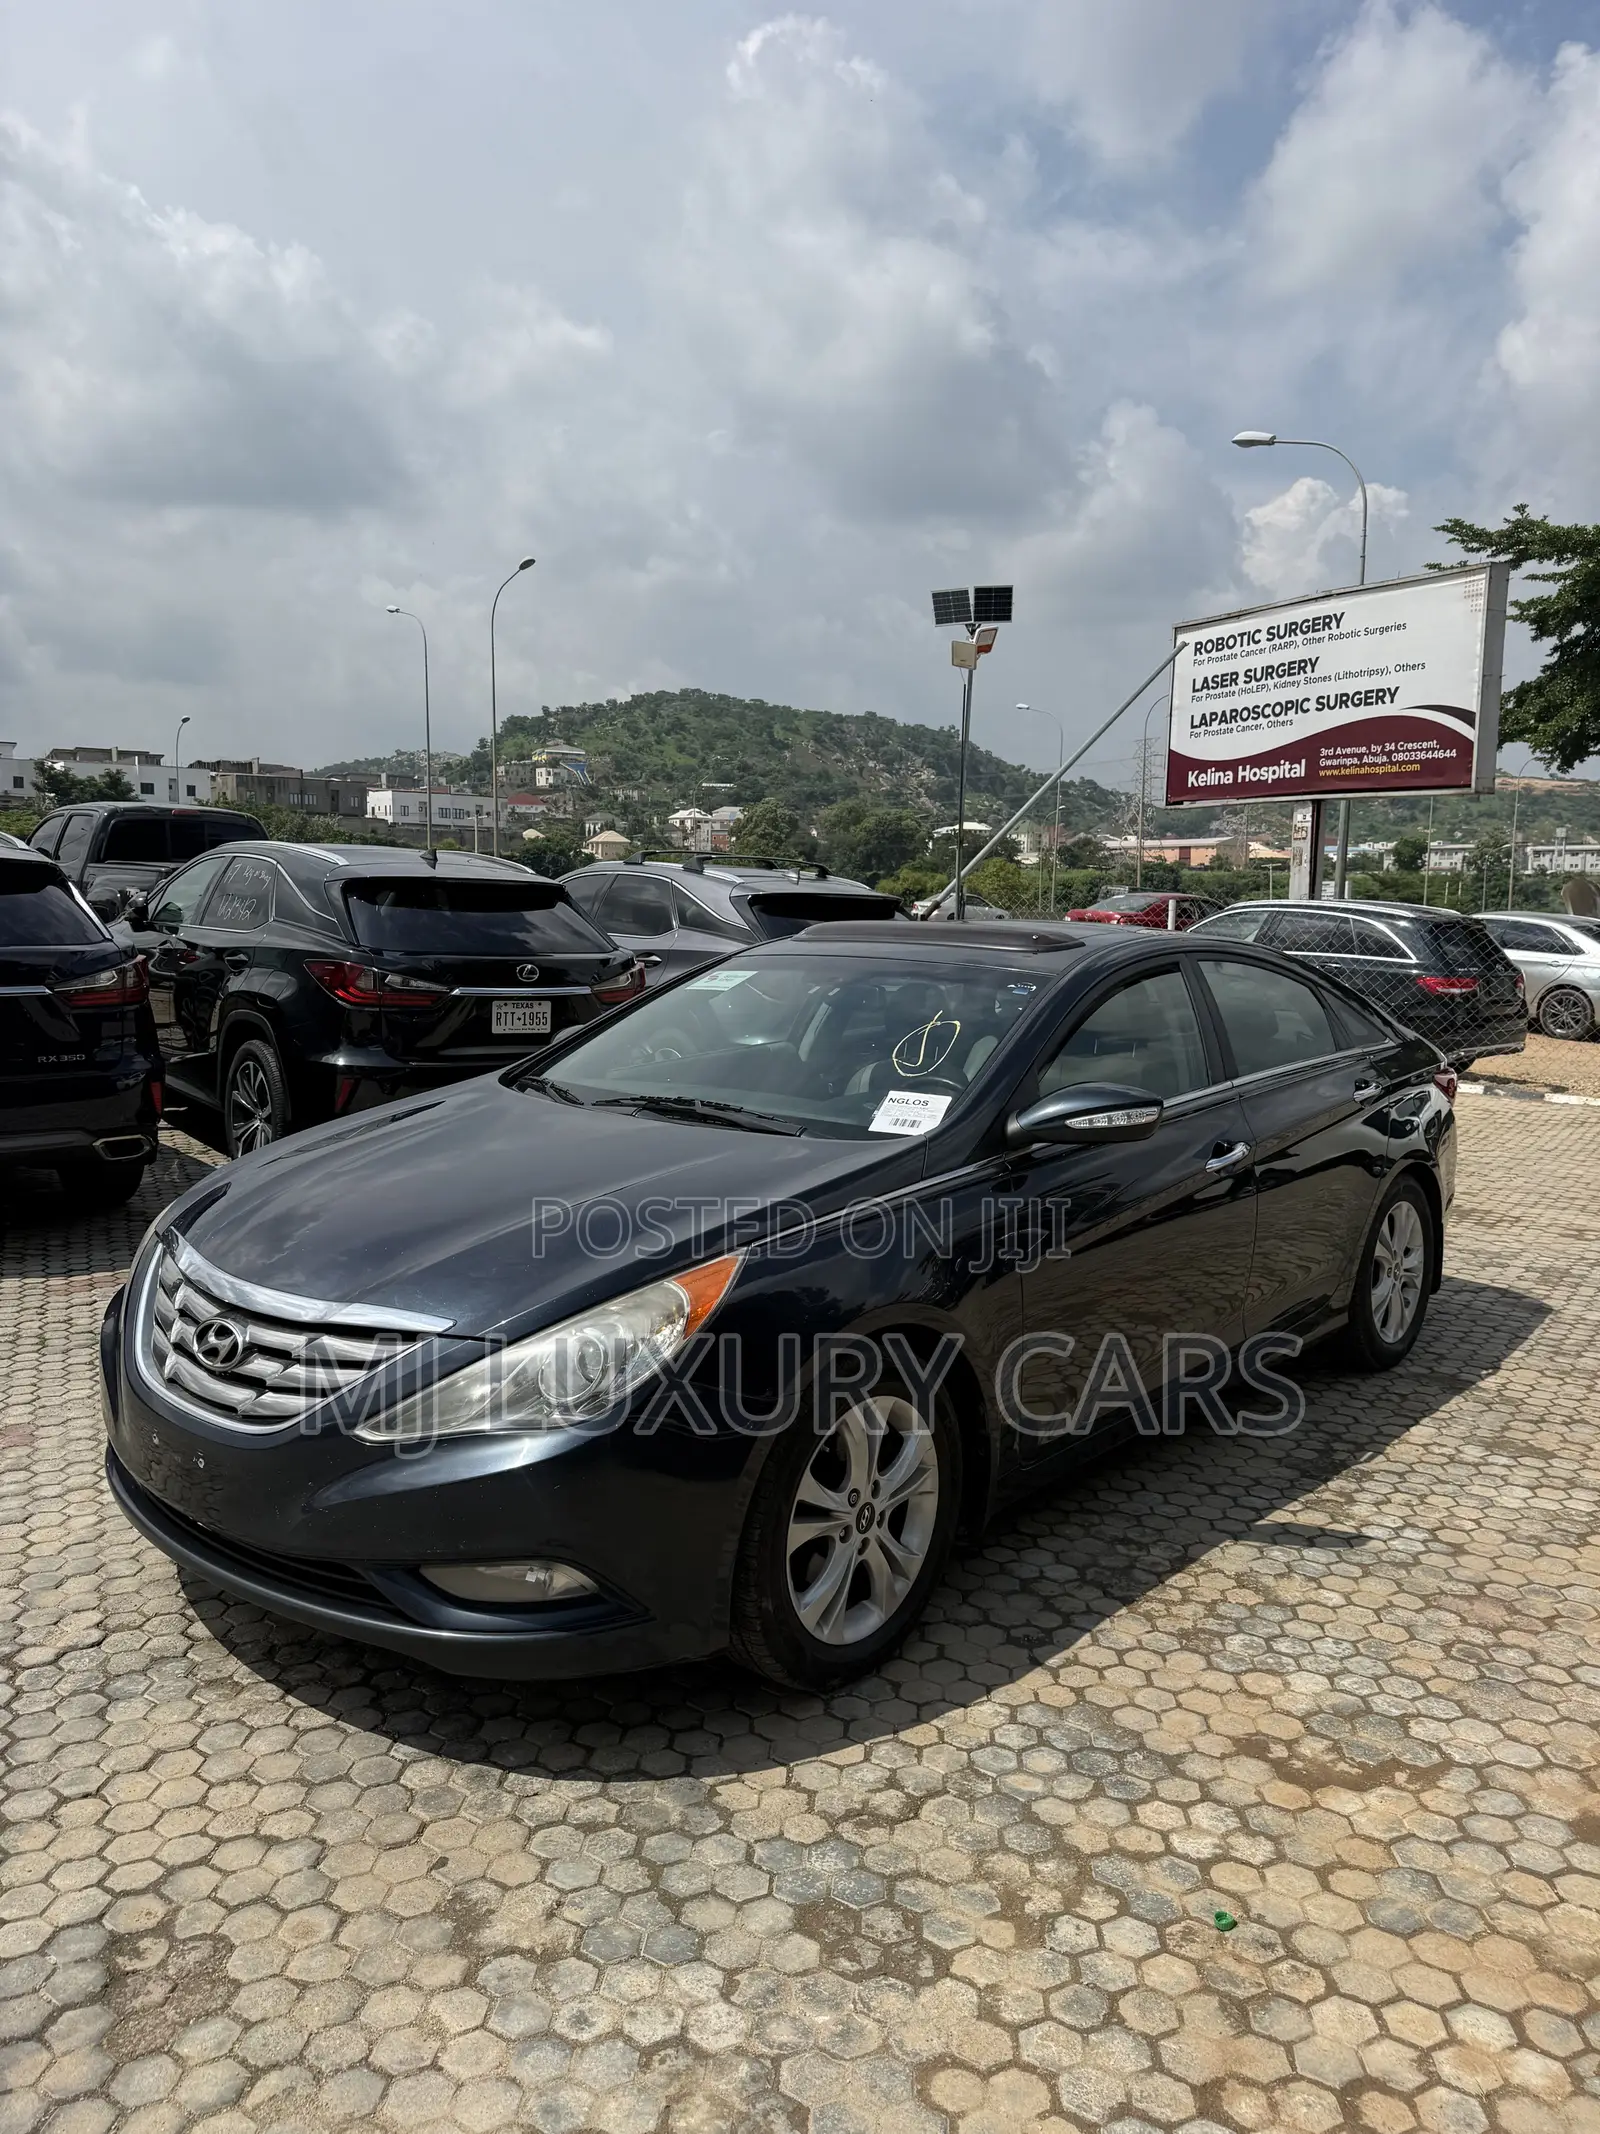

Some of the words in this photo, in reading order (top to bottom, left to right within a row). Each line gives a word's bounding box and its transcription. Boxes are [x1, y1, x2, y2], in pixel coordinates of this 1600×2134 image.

[1193, 628, 1262, 657] ROBOTIC
[1265, 612, 1346, 642] SURGERY
[1193, 659, 1205, 667] For
[1207, 652, 1238, 665] Prostate
[1240, 647, 1267, 658] Cancer
[1269, 640, 1300, 654] (RARP),
[1301, 635, 1326, 646] Other
[1327, 628, 1361, 642] Robotic
[1363, 622, 1407, 636] Surgeries
[1191, 695, 1204, 703] For
[1205, 688, 1236, 701] Prostate
[1237, 683, 1271, 697] (HoLEP),
[1273, 679, 1302, 689] Kidney
[1303, 674, 1332, 685] Stones
[1334, 665, 1392, 682] (Lithotripsy),
[1394, 661, 1426, 673] Others
[1192, 671, 1239, 693] LASER
[1243, 656, 1320, 684] SURGERY
[1190, 697, 1311, 729] LAPAROSCOPIC
[1314, 686, 1400, 712] SURGERY
[1189, 731, 1201, 739] For
[1203, 725, 1234, 738] Prostate
[1236, 722, 1265, 733] Cancer,
[1266, 719, 1293, 729] Others
[1319, 747, 1334, 757] 3rd
[1335, 745, 1369, 755] Avenue,
[1371, 743, 1383, 754] by
[1384, 742, 1396, 751] 34
[1397, 739, 1440, 751] Crescent,
[1319, 756, 1360, 767] Gwarinpa,
[1362, 753, 1390, 765] Abuja.
[1391, 748, 1457, 762] 08033644644
[1187, 767, 1234, 788] Kelina
[1237, 758, 1306, 784] Hospital
[1318, 762, 1421, 777] www.kelinahospital.com
[887, 1097, 930, 1107] NGLOS
